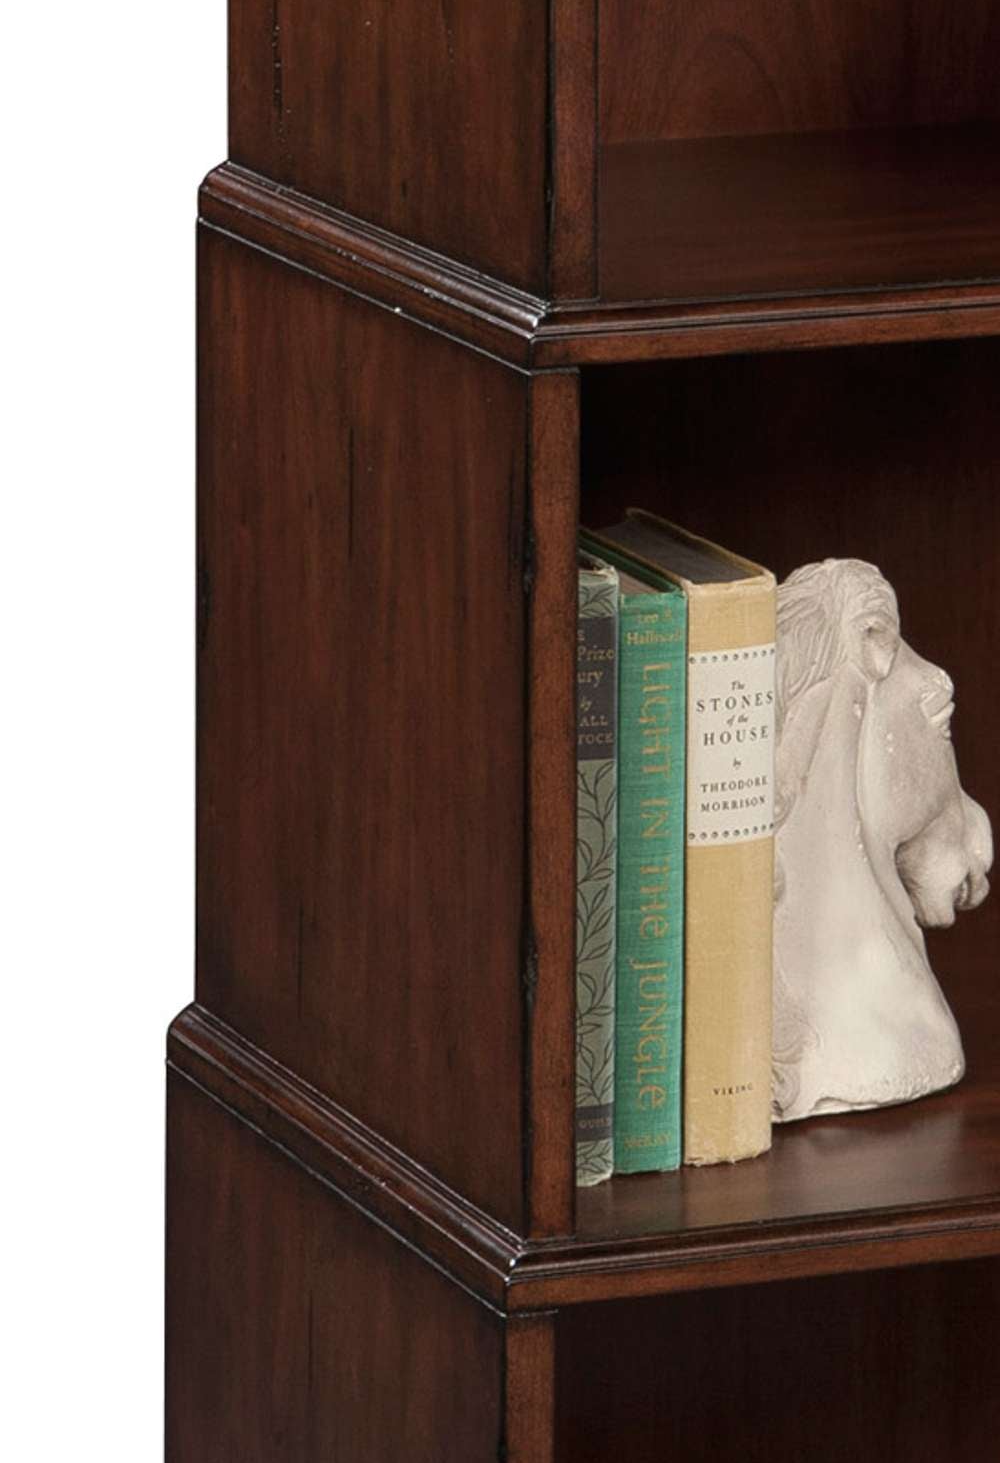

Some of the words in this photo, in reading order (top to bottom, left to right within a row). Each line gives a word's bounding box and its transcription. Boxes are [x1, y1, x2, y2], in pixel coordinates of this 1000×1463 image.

[731, 680, 745, 691] The
[696, 690, 774, 713] STONES
[703, 725, 769, 747] HOUSE
[701, 775, 768, 794] THEODORE
[700, 794, 767, 813] MORRISON
